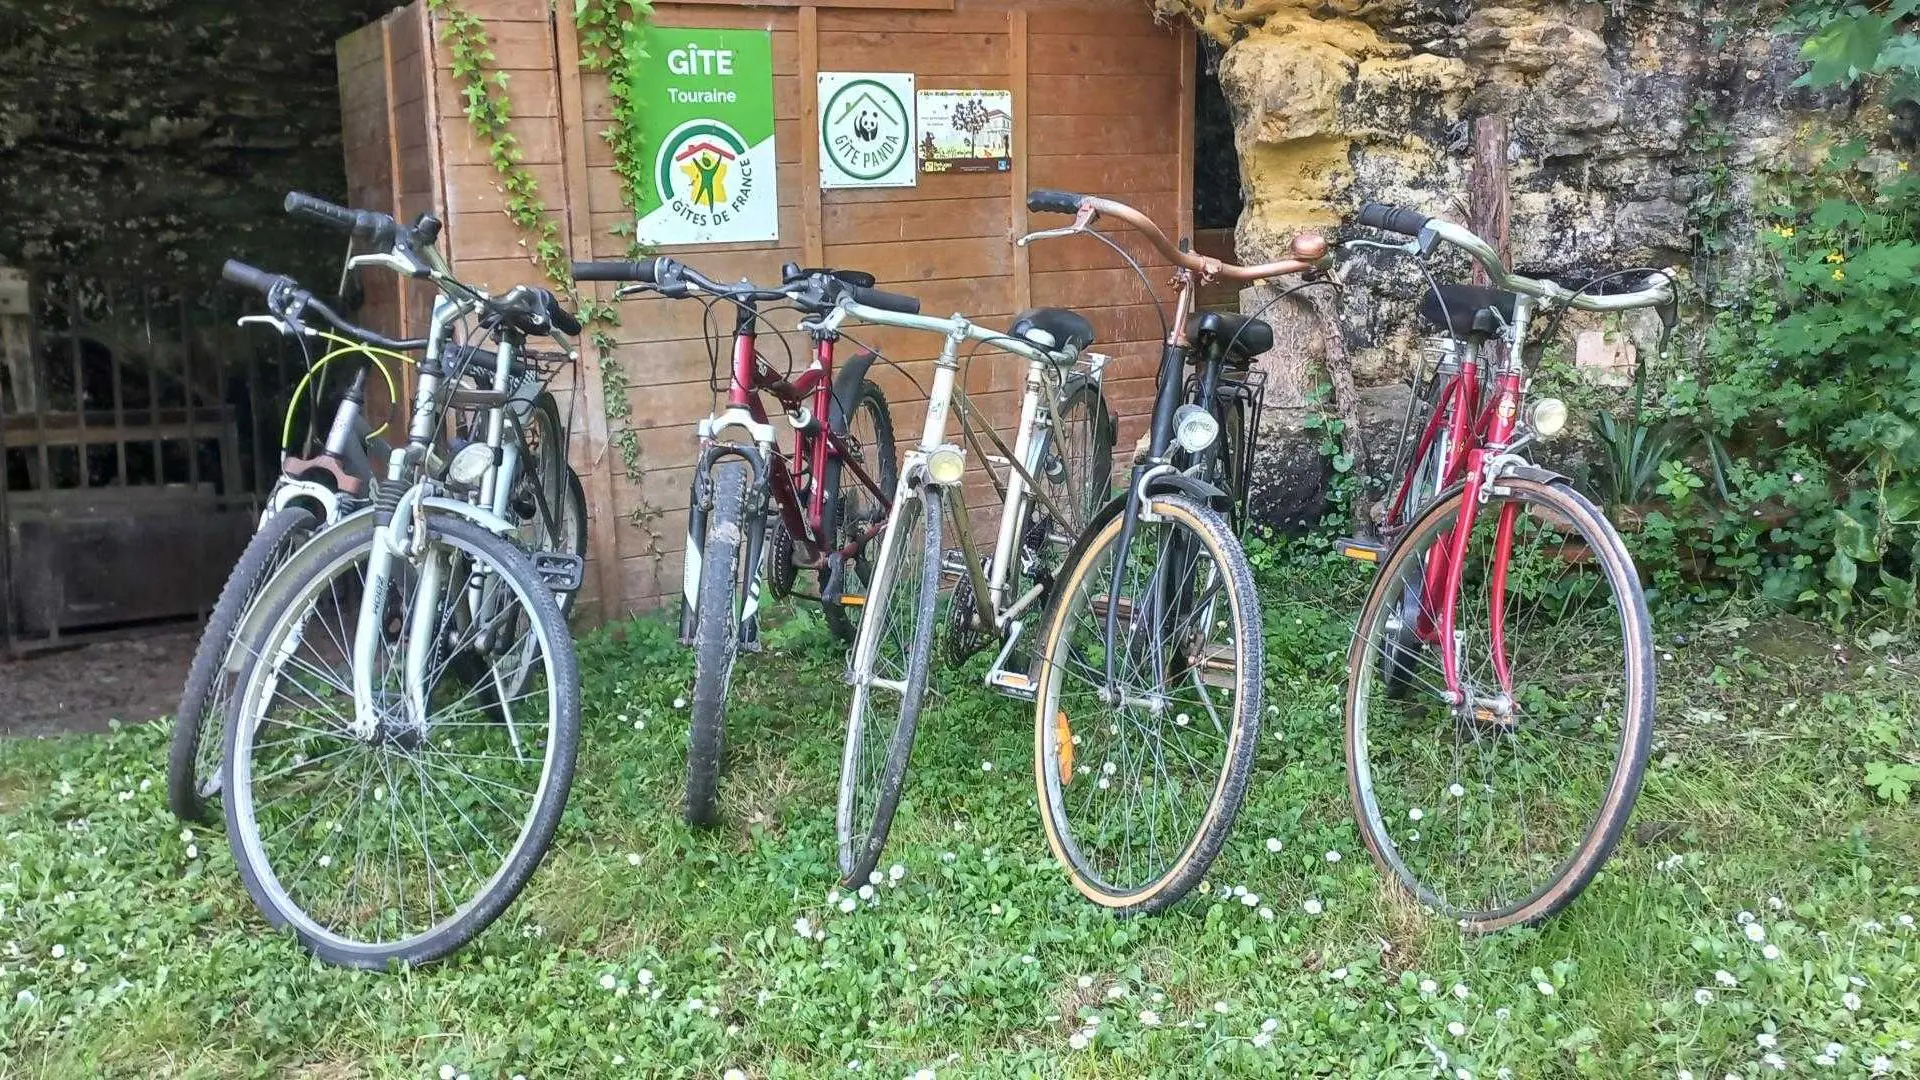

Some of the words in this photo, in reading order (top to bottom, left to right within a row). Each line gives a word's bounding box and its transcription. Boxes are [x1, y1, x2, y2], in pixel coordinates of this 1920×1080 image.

[667, 43, 734, 75] GÎTE
[667, 87, 737, 103] Touraine
[835, 135, 860, 165] GÎTE
[863, 135, 899, 168] PANDA
[672, 200, 707, 226] GÎTES
[713, 210, 730, 226] DE
[732, 158, 753, 213] FRANCE
